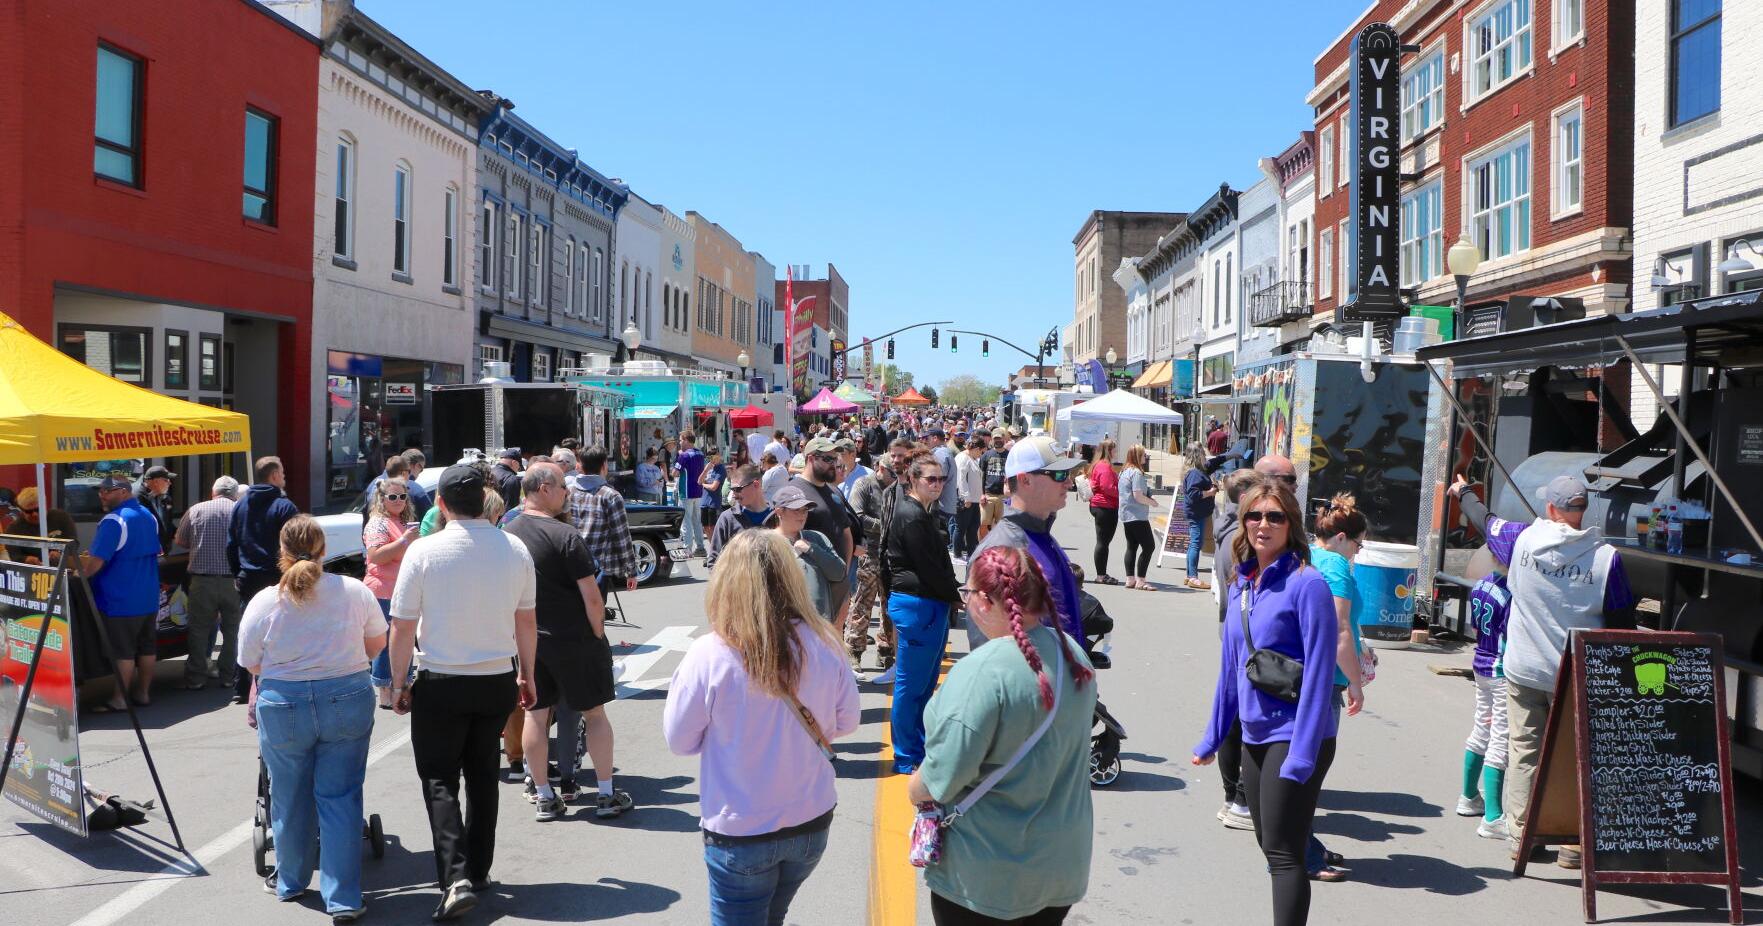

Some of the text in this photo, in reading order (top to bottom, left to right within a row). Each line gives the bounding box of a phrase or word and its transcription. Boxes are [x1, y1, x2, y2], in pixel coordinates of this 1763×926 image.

[1368, 58, 1390, 286] VIRGINIA
[388, 386, 412, 394] FedEx
[55, 424, 242, 452] www.SomernitesCruise.com
[6, 569, 26, 593] This
[20, 599, 28, 608] FT.
[28, 600, 41, 611] OPEN
[1472, 597, 1494, 635] 22
[7, 618, 63, 652] Gatorade
[1632, 651, 1677, 665] CHUCKWAGON
[1586, 665, 1622, 676] Diet Coke
[1596, 839, 1619, 851] Beer
[1619, 839, 1645, 853] Cheese
